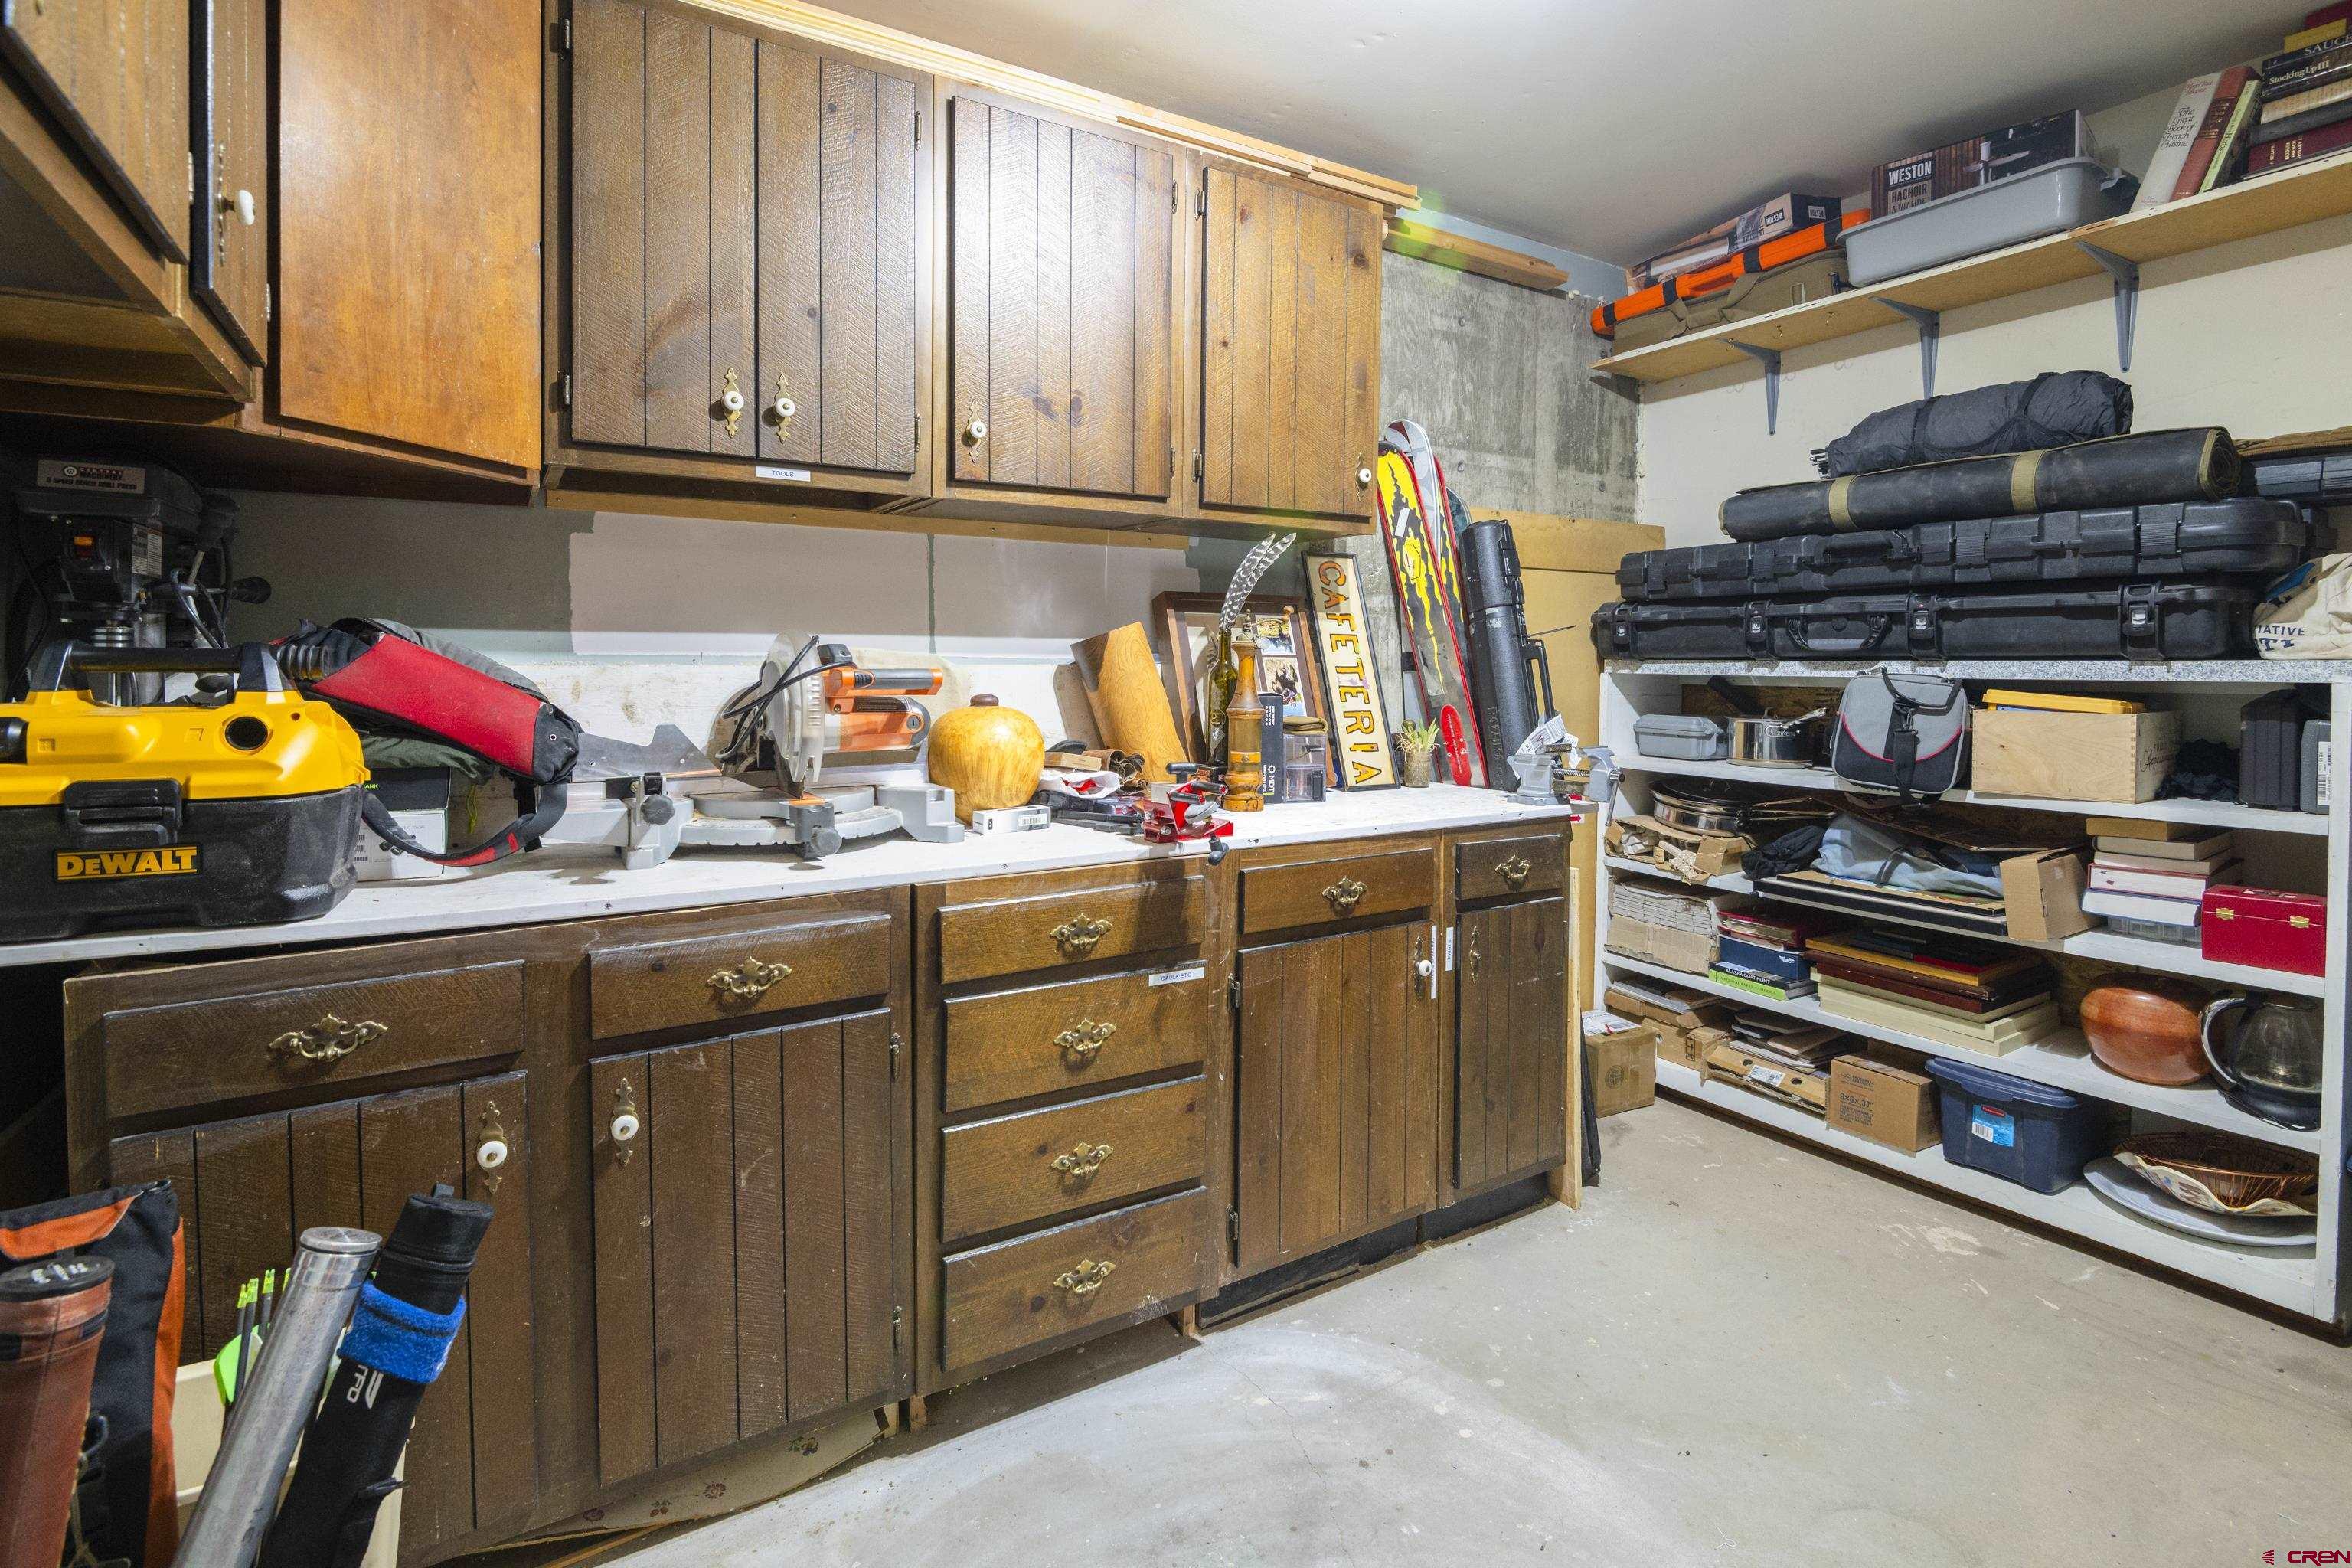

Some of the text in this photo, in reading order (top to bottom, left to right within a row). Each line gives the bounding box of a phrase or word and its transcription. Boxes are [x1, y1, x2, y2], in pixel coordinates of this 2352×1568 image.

[2269, 67, 2305, 85] Stocking
[1888, 160, 1932, 185] WESTON
[1891, 183, 1927, 203] HACHOIR
[772, 469, 795, 478] TOOLS
[2256, 624, 2306, 636] IATIVE
[1318, 560, 1383, 785] CAFETERIA
[57, 849, 198, 877] DEWALT
[1725, 968, 1770, 985] ALASKA GOAT HUNT
